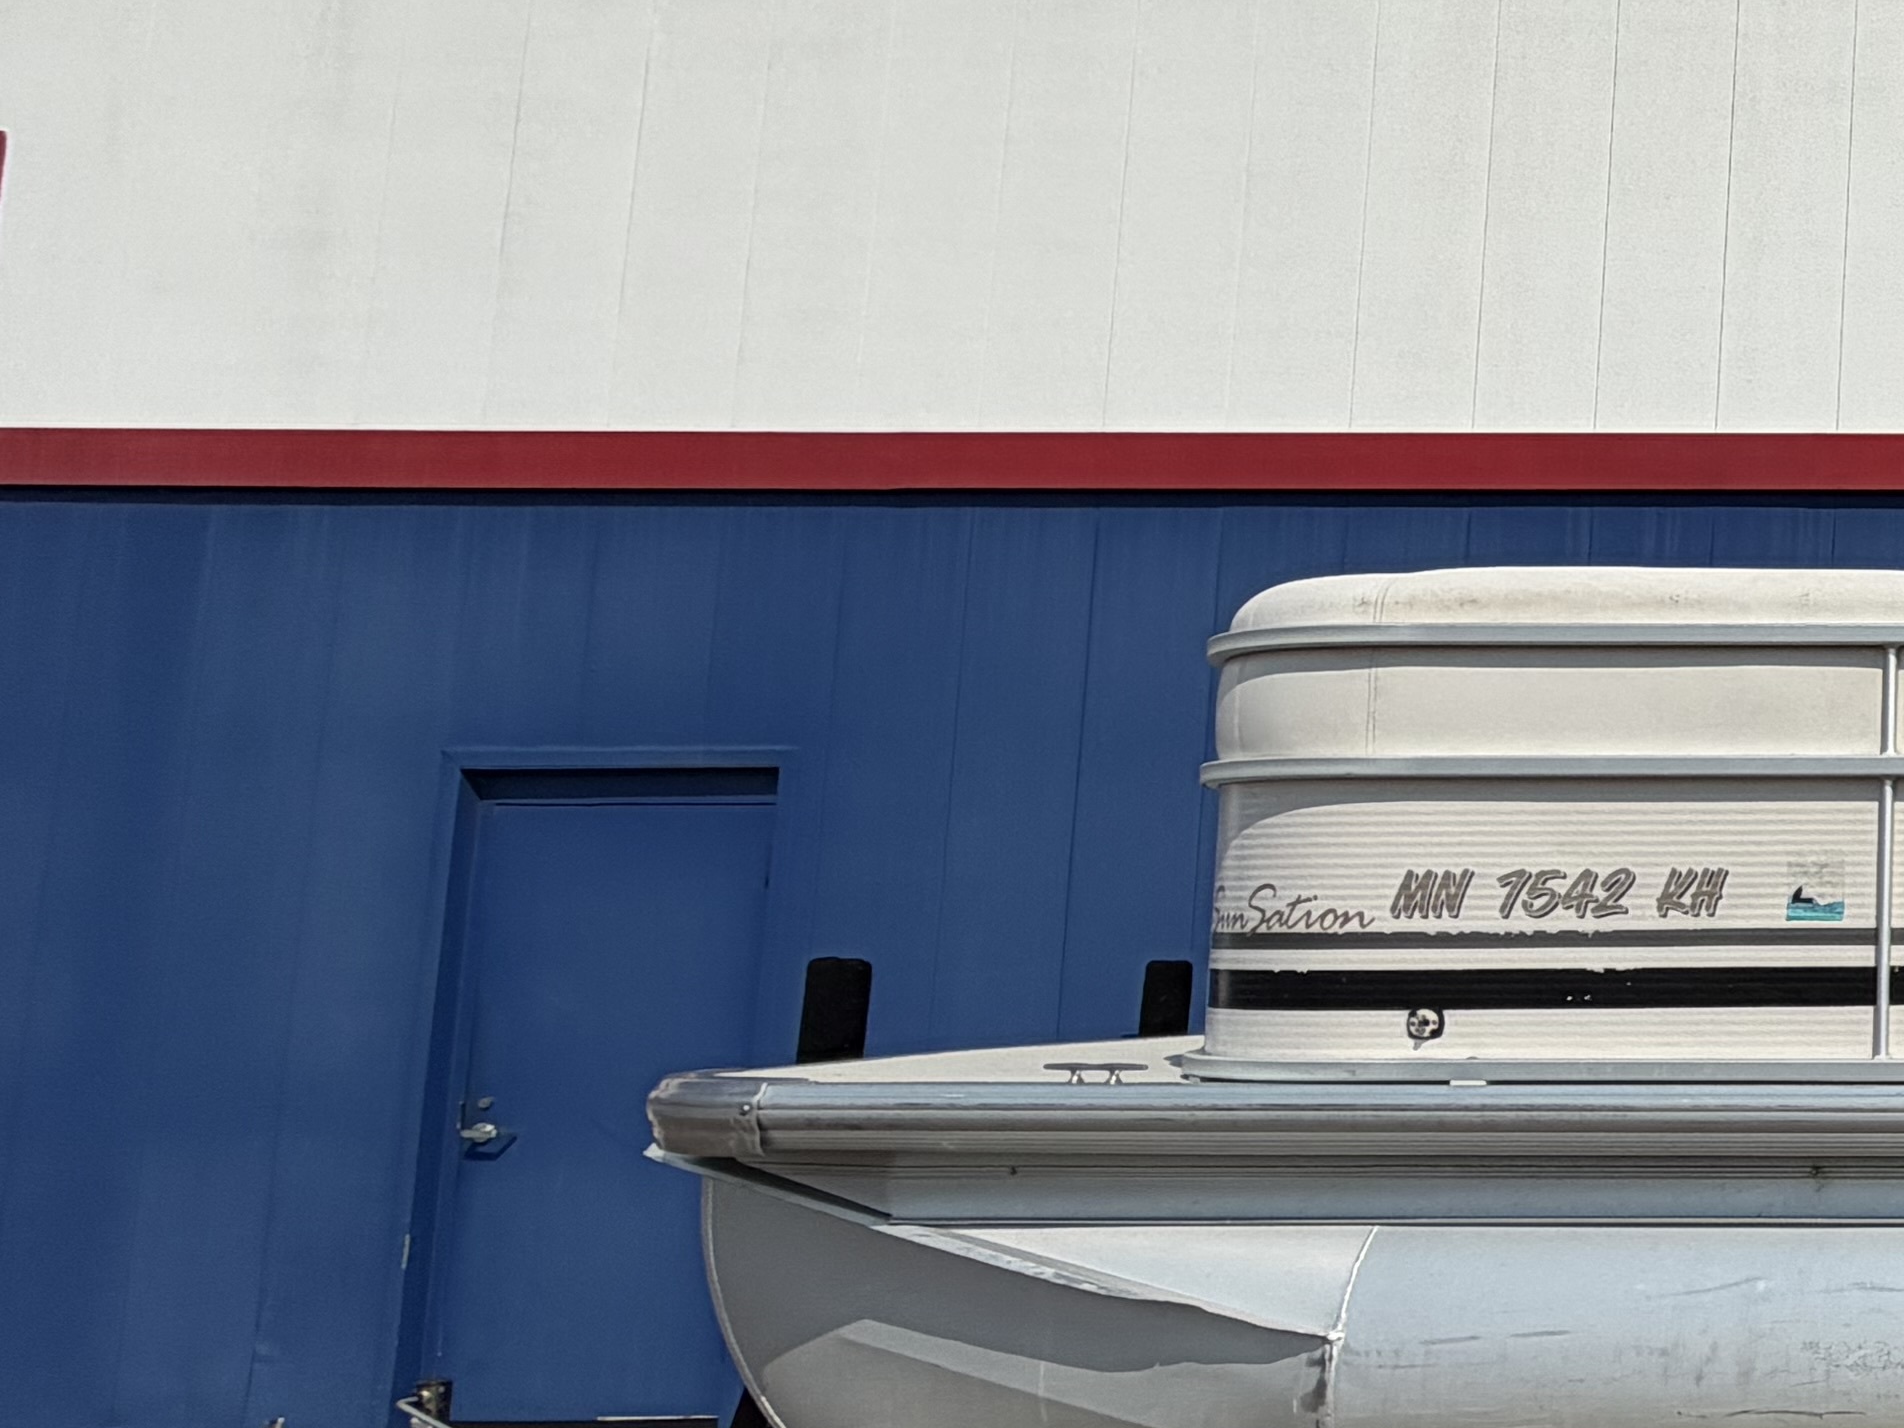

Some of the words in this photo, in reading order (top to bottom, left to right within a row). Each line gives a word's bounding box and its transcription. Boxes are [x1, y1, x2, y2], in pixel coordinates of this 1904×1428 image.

[1388, 868, 1476, 919] MN
[1496, 868, 1637, 920] 7542
[1655, 867, 1730, 918] KH
